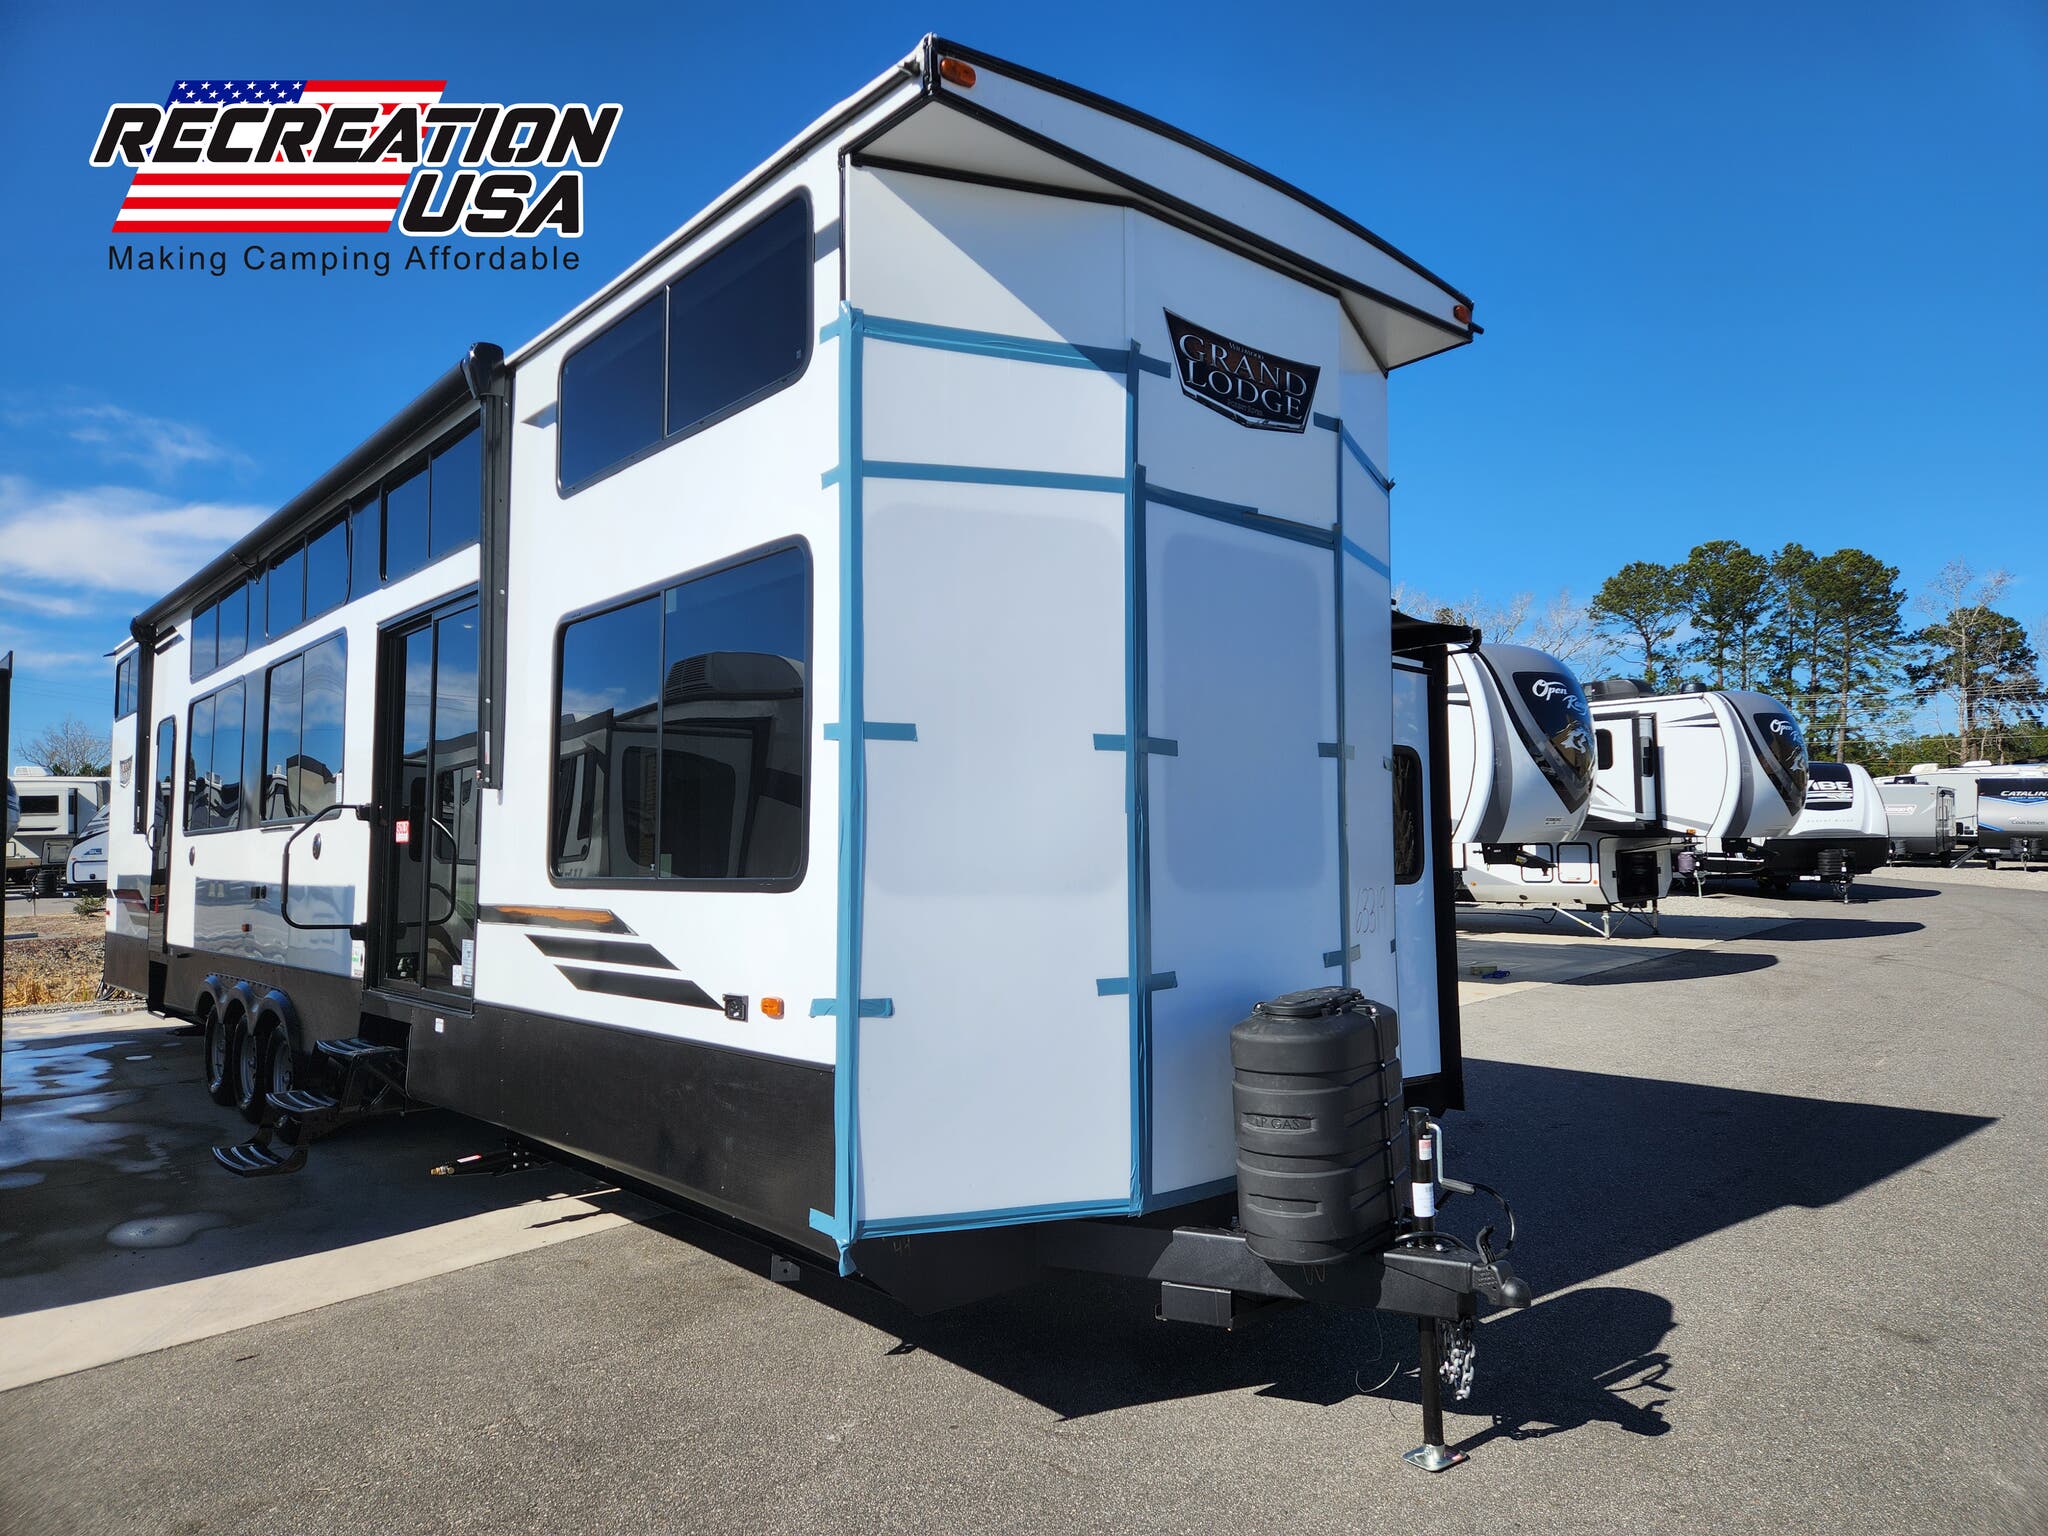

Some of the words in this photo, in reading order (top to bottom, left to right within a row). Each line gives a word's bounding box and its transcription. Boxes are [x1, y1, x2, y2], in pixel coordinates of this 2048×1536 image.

[1179, 334, 1307, 397] GRAND
[1186, 359, 1303, 419] LODGE
[1532, 679, 1568, 701] Open
[1770, 719, 1793, 735] Open
[1271, 1118, 1301, 1130] GAS
